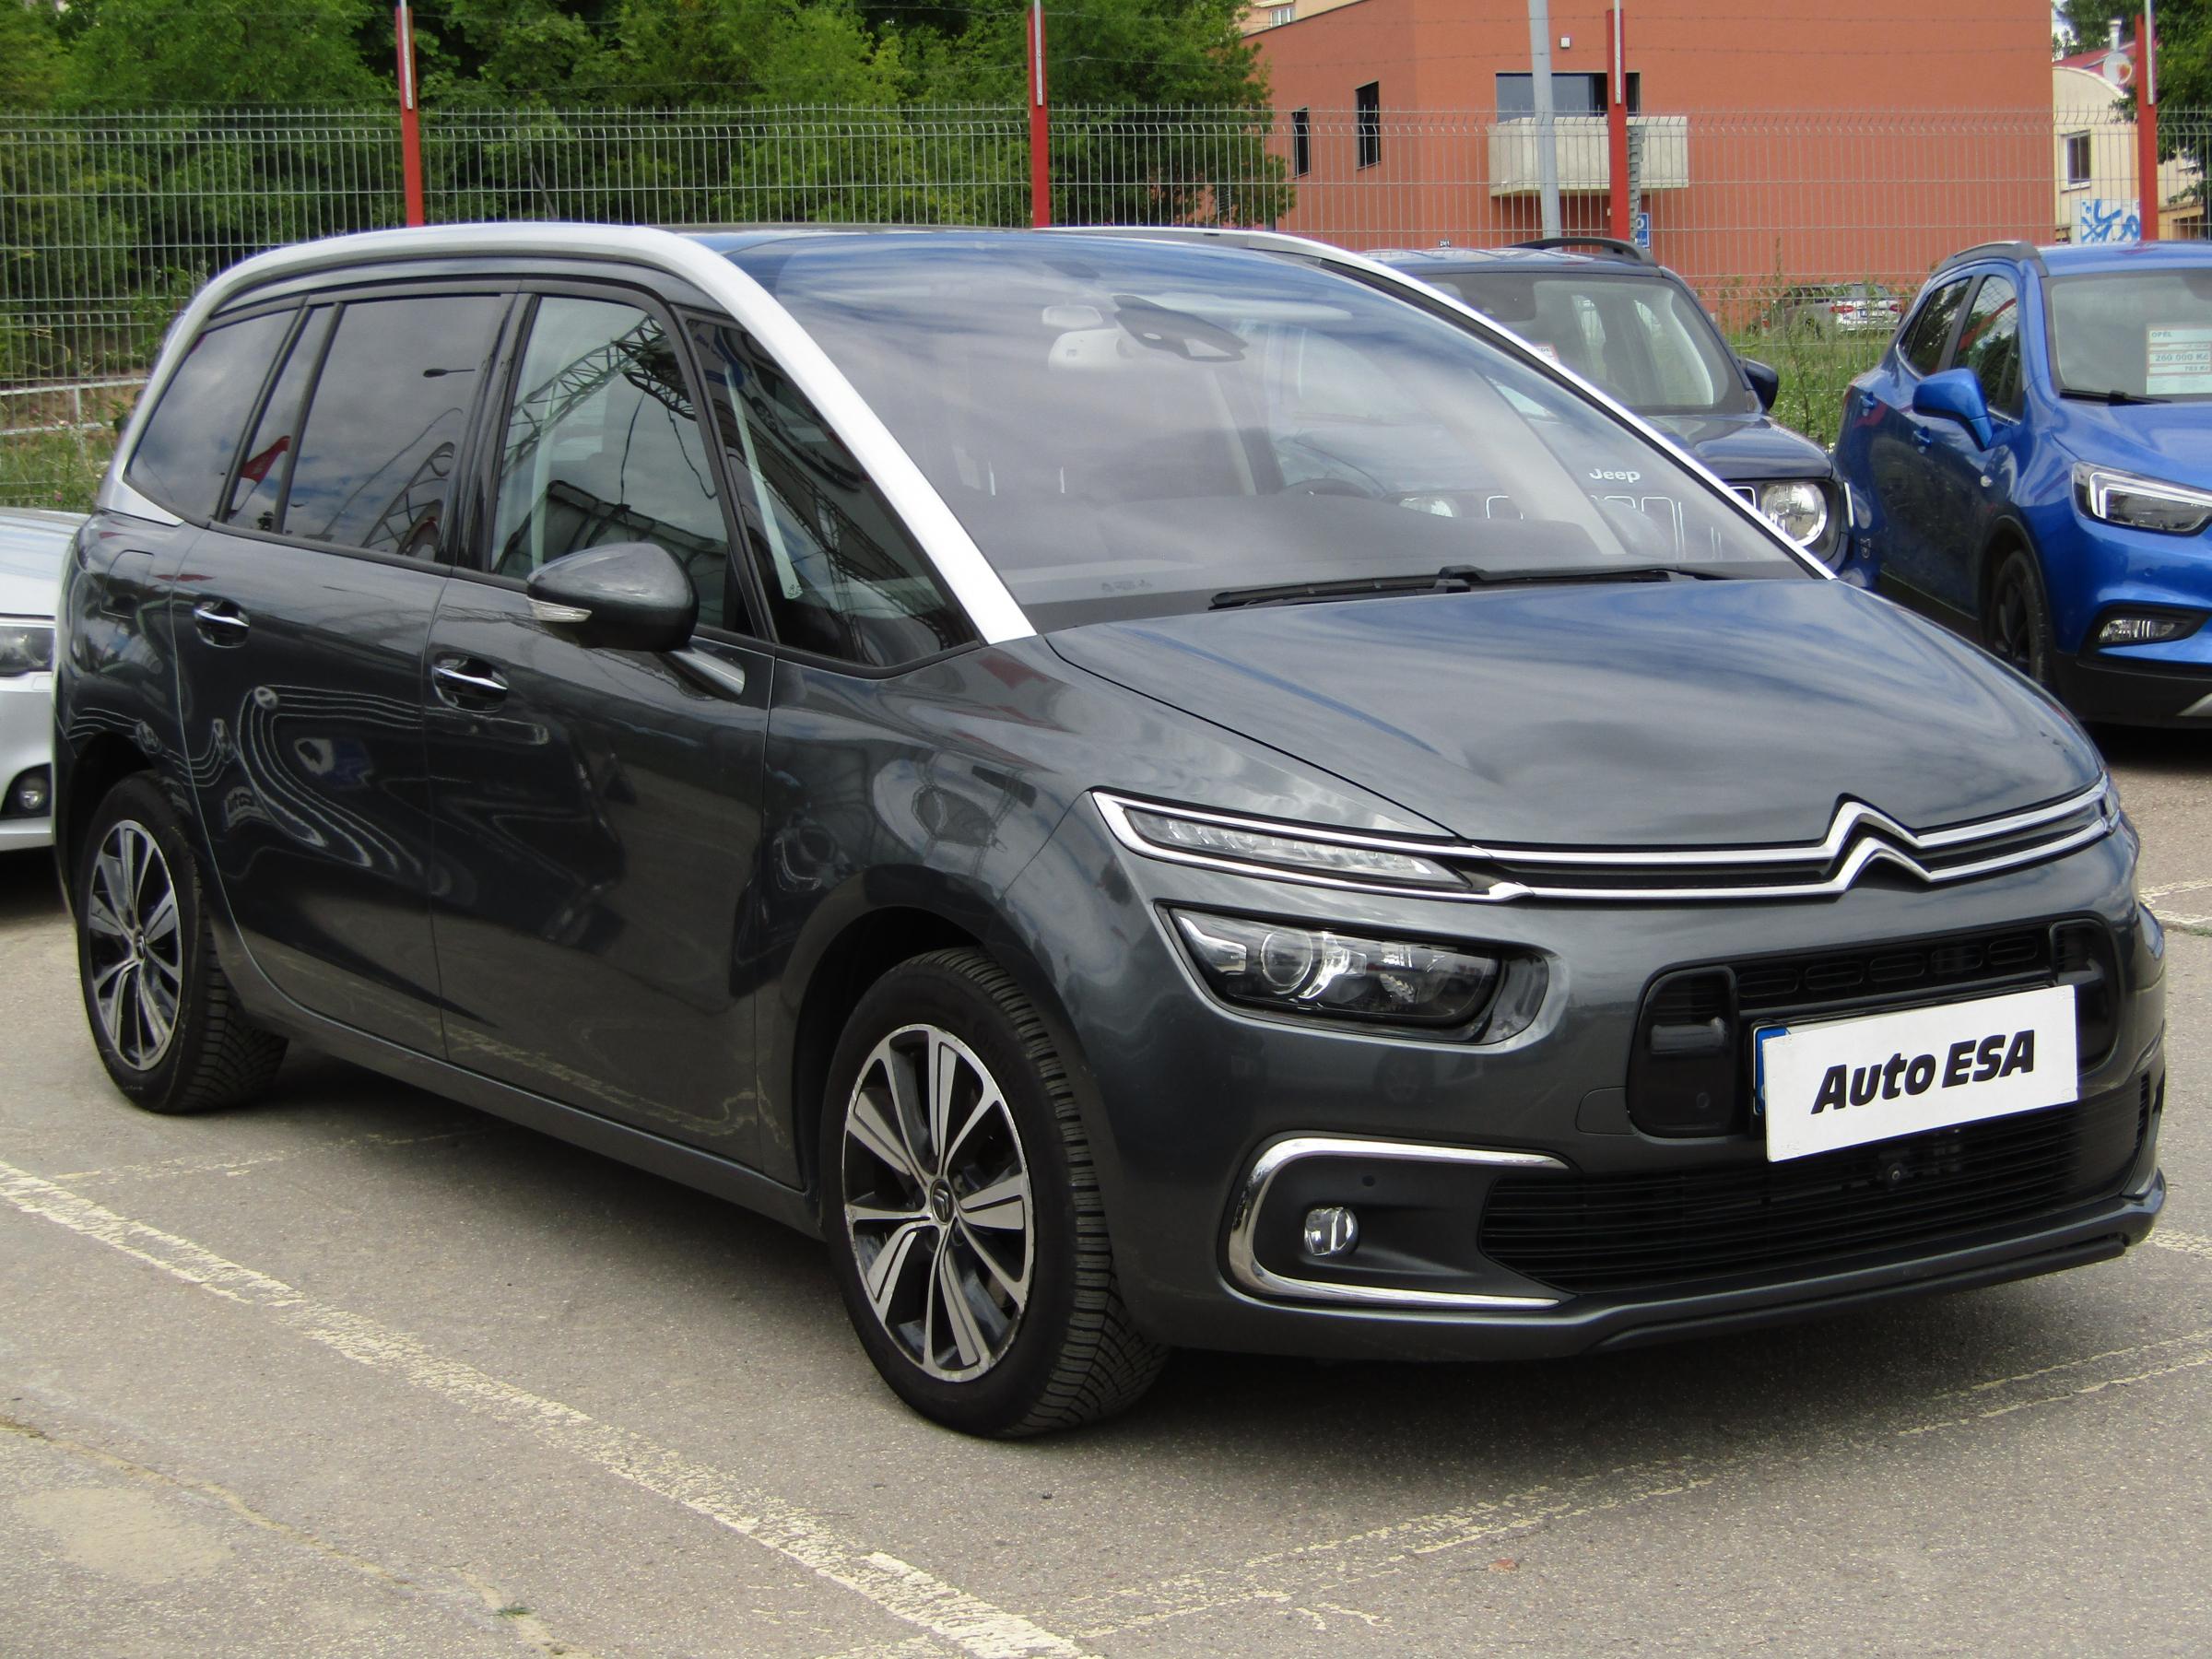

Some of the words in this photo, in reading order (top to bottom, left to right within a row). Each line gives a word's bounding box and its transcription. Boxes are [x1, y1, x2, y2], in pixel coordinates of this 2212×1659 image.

[1589, 468, 1641, 483] Jeep
[1810, 1053, 1936, 1115] Auto
[1941, 1030, 2035, 1088] ESA
